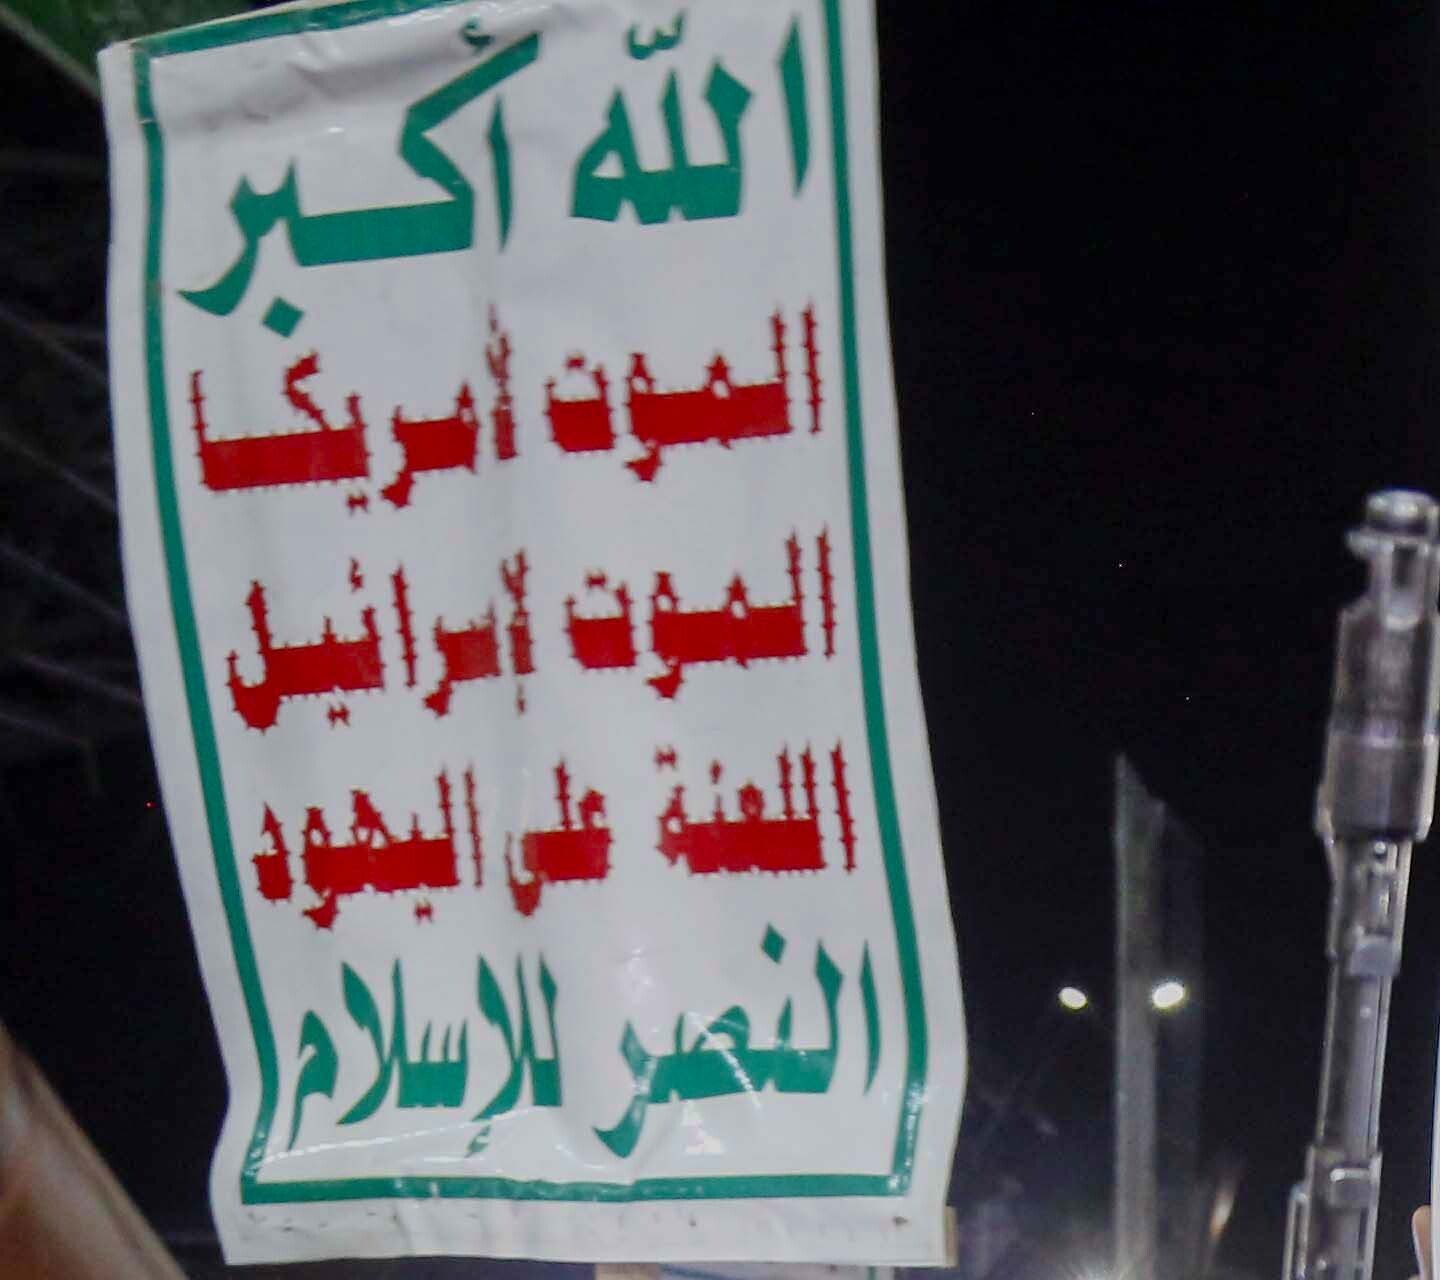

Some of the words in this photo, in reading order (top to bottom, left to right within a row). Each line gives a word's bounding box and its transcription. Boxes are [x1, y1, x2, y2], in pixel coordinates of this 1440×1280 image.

[177, 16, 543, 338] أكبر
[571, 11, 811, 226] الله
[190, 302, 519, 512] لأمريكا
[546, 299, 825, 483] الموت
[225, 548, 535, 732] لإسرائيل
[565, 524, 836, 699] الموت
[251, 763, 485, 930] اليهود
[505, 752, 613, 918] على
[656, 738, 857, 875] اللعنة
[286, 949, 559, 1158] للإسلام
[593, 923, 883, 1158] النصر
